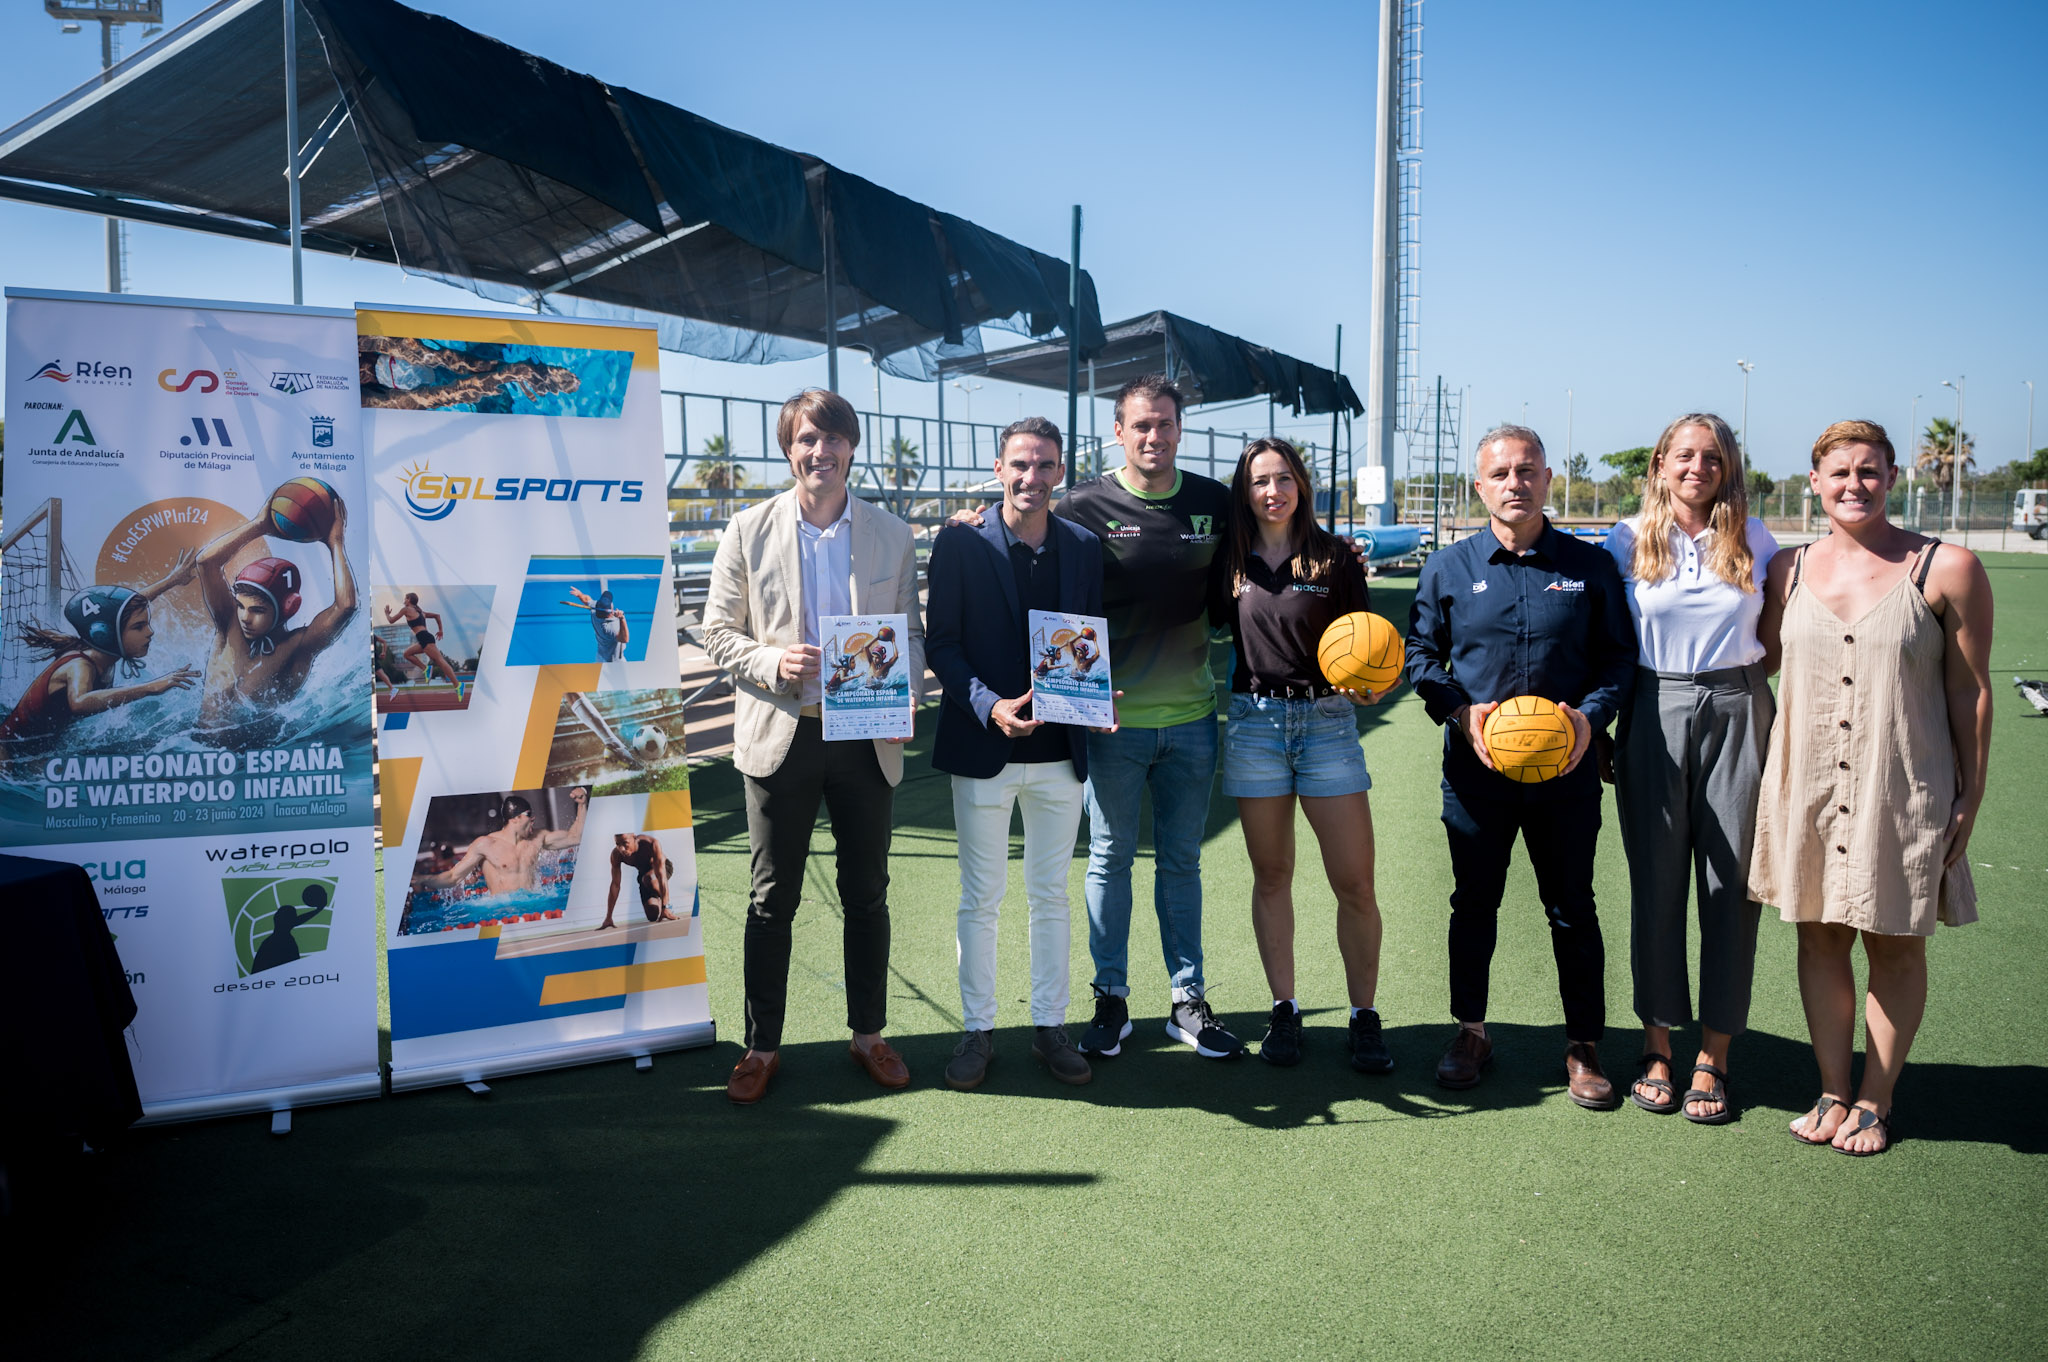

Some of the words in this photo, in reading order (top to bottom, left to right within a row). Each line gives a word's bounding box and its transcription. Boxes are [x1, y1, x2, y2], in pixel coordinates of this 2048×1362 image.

[76, 361, 132, 379] Rfen
[28, 448, 57, 457] Junta
[59, 448, 73, 457] de
[74, 449, 125, 459] Andalucía
[159, 450, 209, 461] Diputación
[211, 451, 255, 461] Provincial
[291, 451, 355, 461] Ayuntamiento
[184, 461, 196, 469] de
[197, 461, 231, 471] Málaga
[299, 461, 311, 470] de
[313, 461, 347, 472] Málaga
[282, 569, 293, 589] 1
[1292, 582, 1329, 594] inacua
[81, 596, 101, 618] 4
[46, 752, 237, 782] CAMPEONATO
[246, 743, 344, 774] ESPAÑA
[46, 786, 78, 809] DE
[86, 779, 236, 807] WATERPOLO
[244, 774, 345, 800] INFANTIL
[45, 813, 98, 829] Masculino
[101, 817, 108, 829] y
[111, 811, 161, 825] Femenino
[173, 809, 186, 823] 20
[195, 808, 209, 821] 23
[211, 807, 236, 823] junio
[239, 805, 264, 818] 2024
[275, 804, 308, 816] Inacua
[310, 800, 346, 816] Málaga
[205, 839, 349, 862] waterpolo
[82, 859, 146, 881] cua
[104, 885, 146, 895] Málaga
[213, 979, 276, 993] desde
[284, 973, 340, 987] 2004
